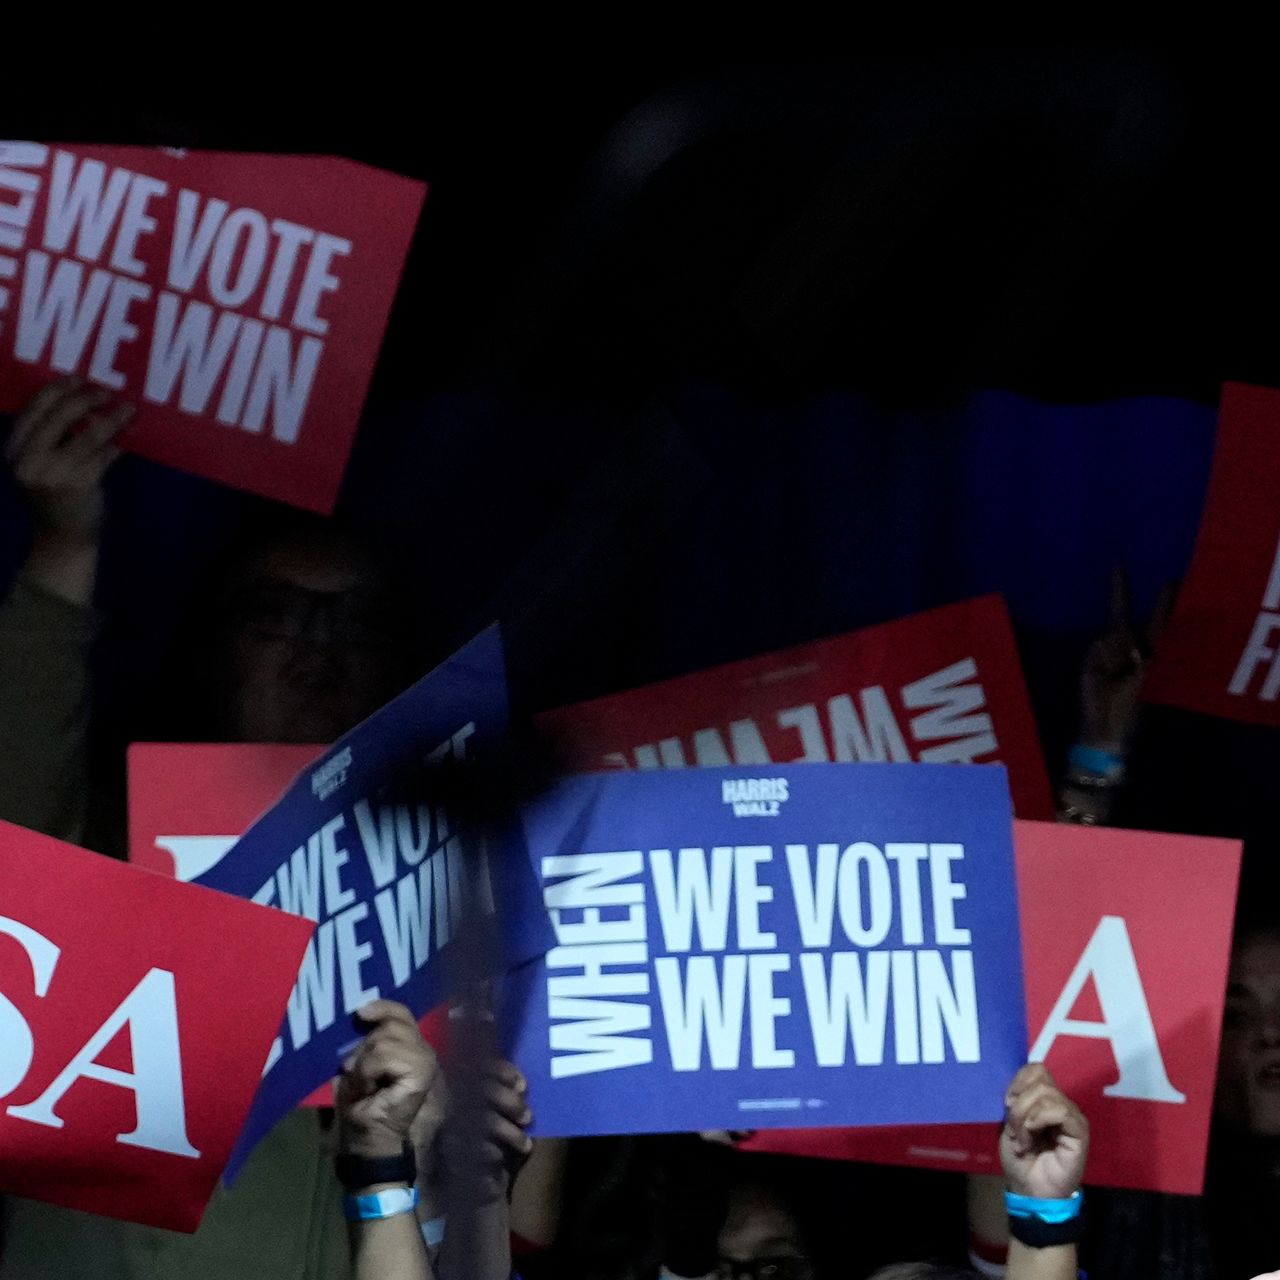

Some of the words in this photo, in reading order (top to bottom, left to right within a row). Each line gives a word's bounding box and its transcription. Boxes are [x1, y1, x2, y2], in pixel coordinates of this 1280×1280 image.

[41, 150, 169, 276] WE
[166, 188, 353, 335] VOTE
[13, 249, 152, 388] WE
[143, 291, 325, 445] WIN
[722, 778, 789, 804] HARRIS
[732, 801, 780, 818] WALZ
[648, 845, 778, 953] WE
[784, 840, 972, 948] VOTE
[541, 848, 655, 1080] WHEN
[654, 951, 796, 1073] WE
[799, 949, 982, 1068] WIN
